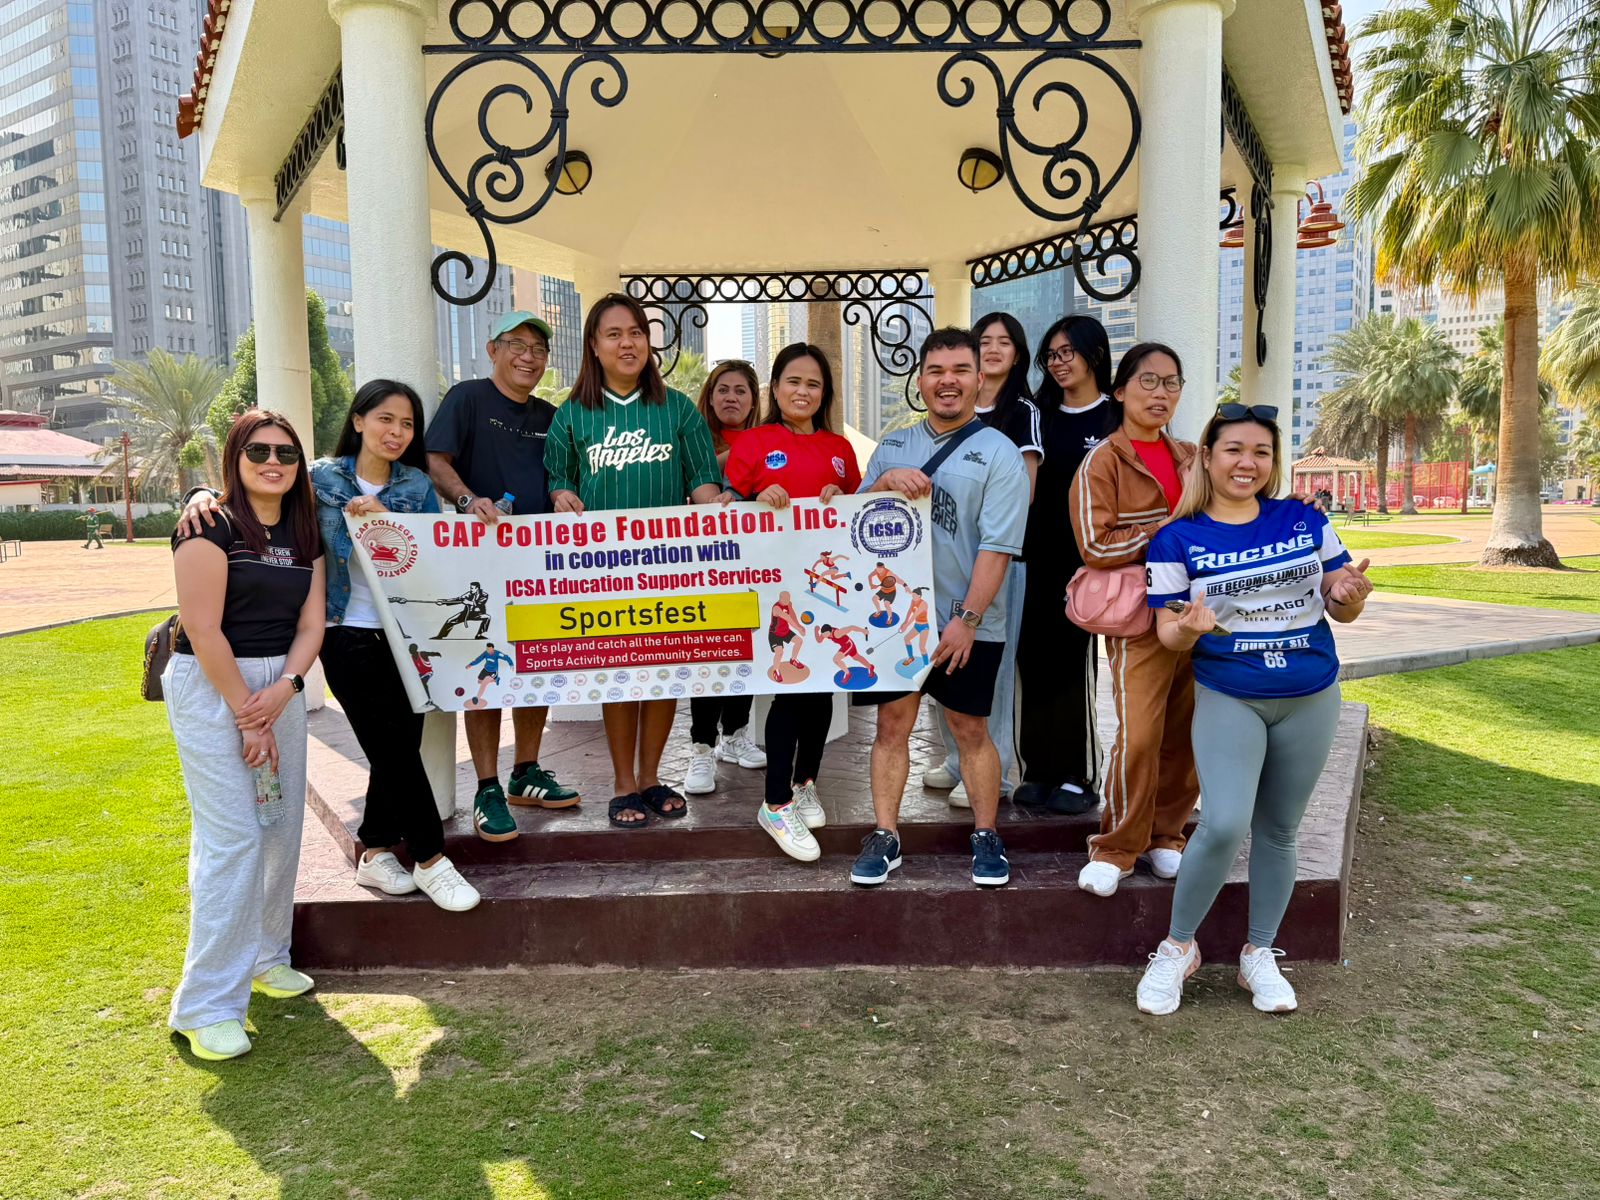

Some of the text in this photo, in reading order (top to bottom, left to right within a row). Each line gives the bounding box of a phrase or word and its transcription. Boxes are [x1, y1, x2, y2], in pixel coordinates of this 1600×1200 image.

[603, 426, 646, 448] Los
[587, 437, 673, 476] Angeles
[433, 520, 486, 547] CAP
[497, 520, 606, 547] College
[616, 509, 783, 541] Foundation.
[793, 505, 846, 530] Inc.
[868, 522, 904, 537] ICSA
[279, 558, 293, 566] STOP
[355, 519, 418, 577] CAP COLLEGE FOUNDATIO
[545, 540, 740, 570] in cooperation with
[1191, 533, 1314, 570] RACING
[505, 567, 782, 597] ICSA Education Support Services
[1206, 562, 1320, 595] LIFE BECOMES LIMITLESS
[560, 601, 707, 635] Sportsfest
[522, 634, 745, 654] Let's play and catch all the fun that we can.
[526, 647, 743, 670] Sports Activity and Community Services.
[1233, 637, 1309, 652] FOURTY SIX
[1263, 651, 1287, 668] 66
